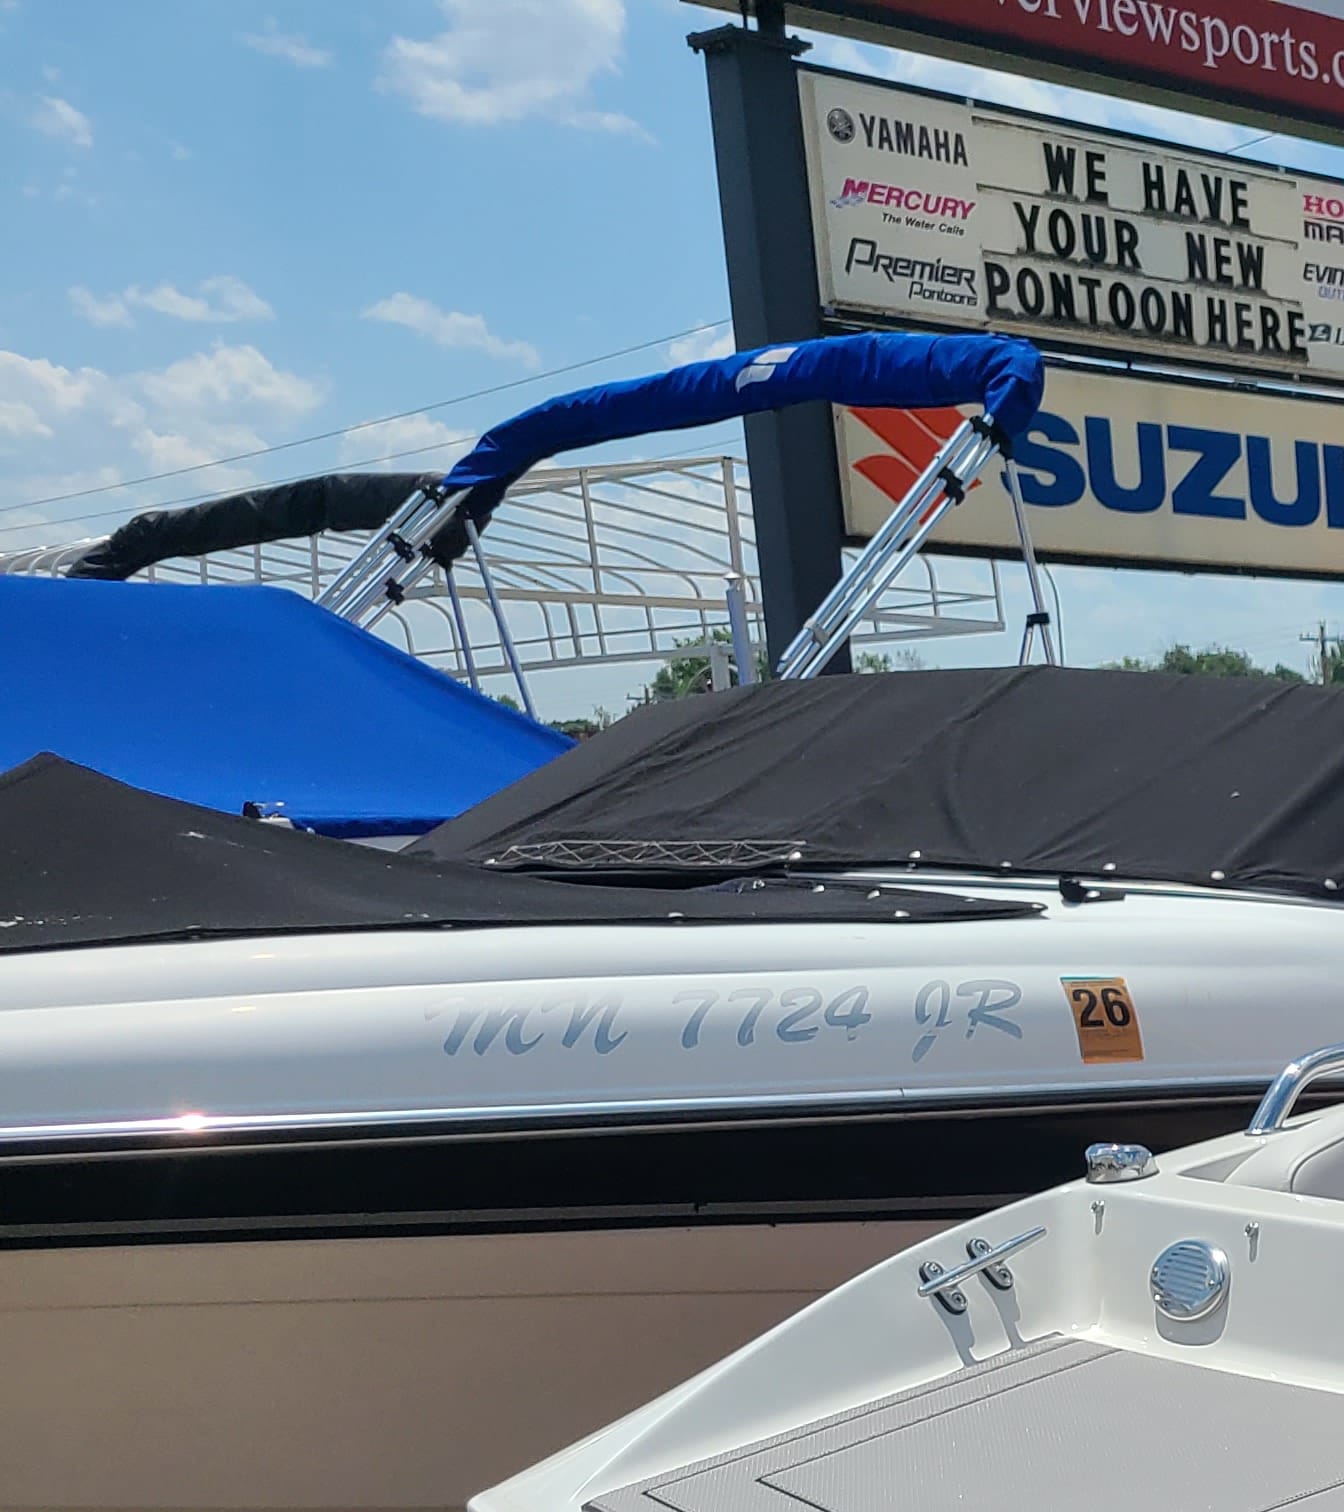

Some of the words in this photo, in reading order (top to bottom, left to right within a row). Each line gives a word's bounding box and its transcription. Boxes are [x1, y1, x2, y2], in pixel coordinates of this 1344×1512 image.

[860, 113, 969, 167] YAMAHA
[841, 178, 976, 220] MERCURY
[1043, 142, 1109, 200] WE
[1142, 161, 1250, 228] HAVE
[882, 213, 902, 225] The
[905, 215, 935, 231] Water
[939, 222, 965, 236] Calls
[1013, 201, 1142, 269] YOUR
[1185, 231, 1264, 289] NEW
[909, 282, 978, 306] Pontoons
[984, 261, 1194, 340] PONTOON
[1207, 296, 1308, 353] HERE
[425, 990, 628, 1057] MN
[670, 986, 872, 1050] 7724
[912, 979, 1024, 1064] JR
[1072, 988, 1130, 1027] 26
